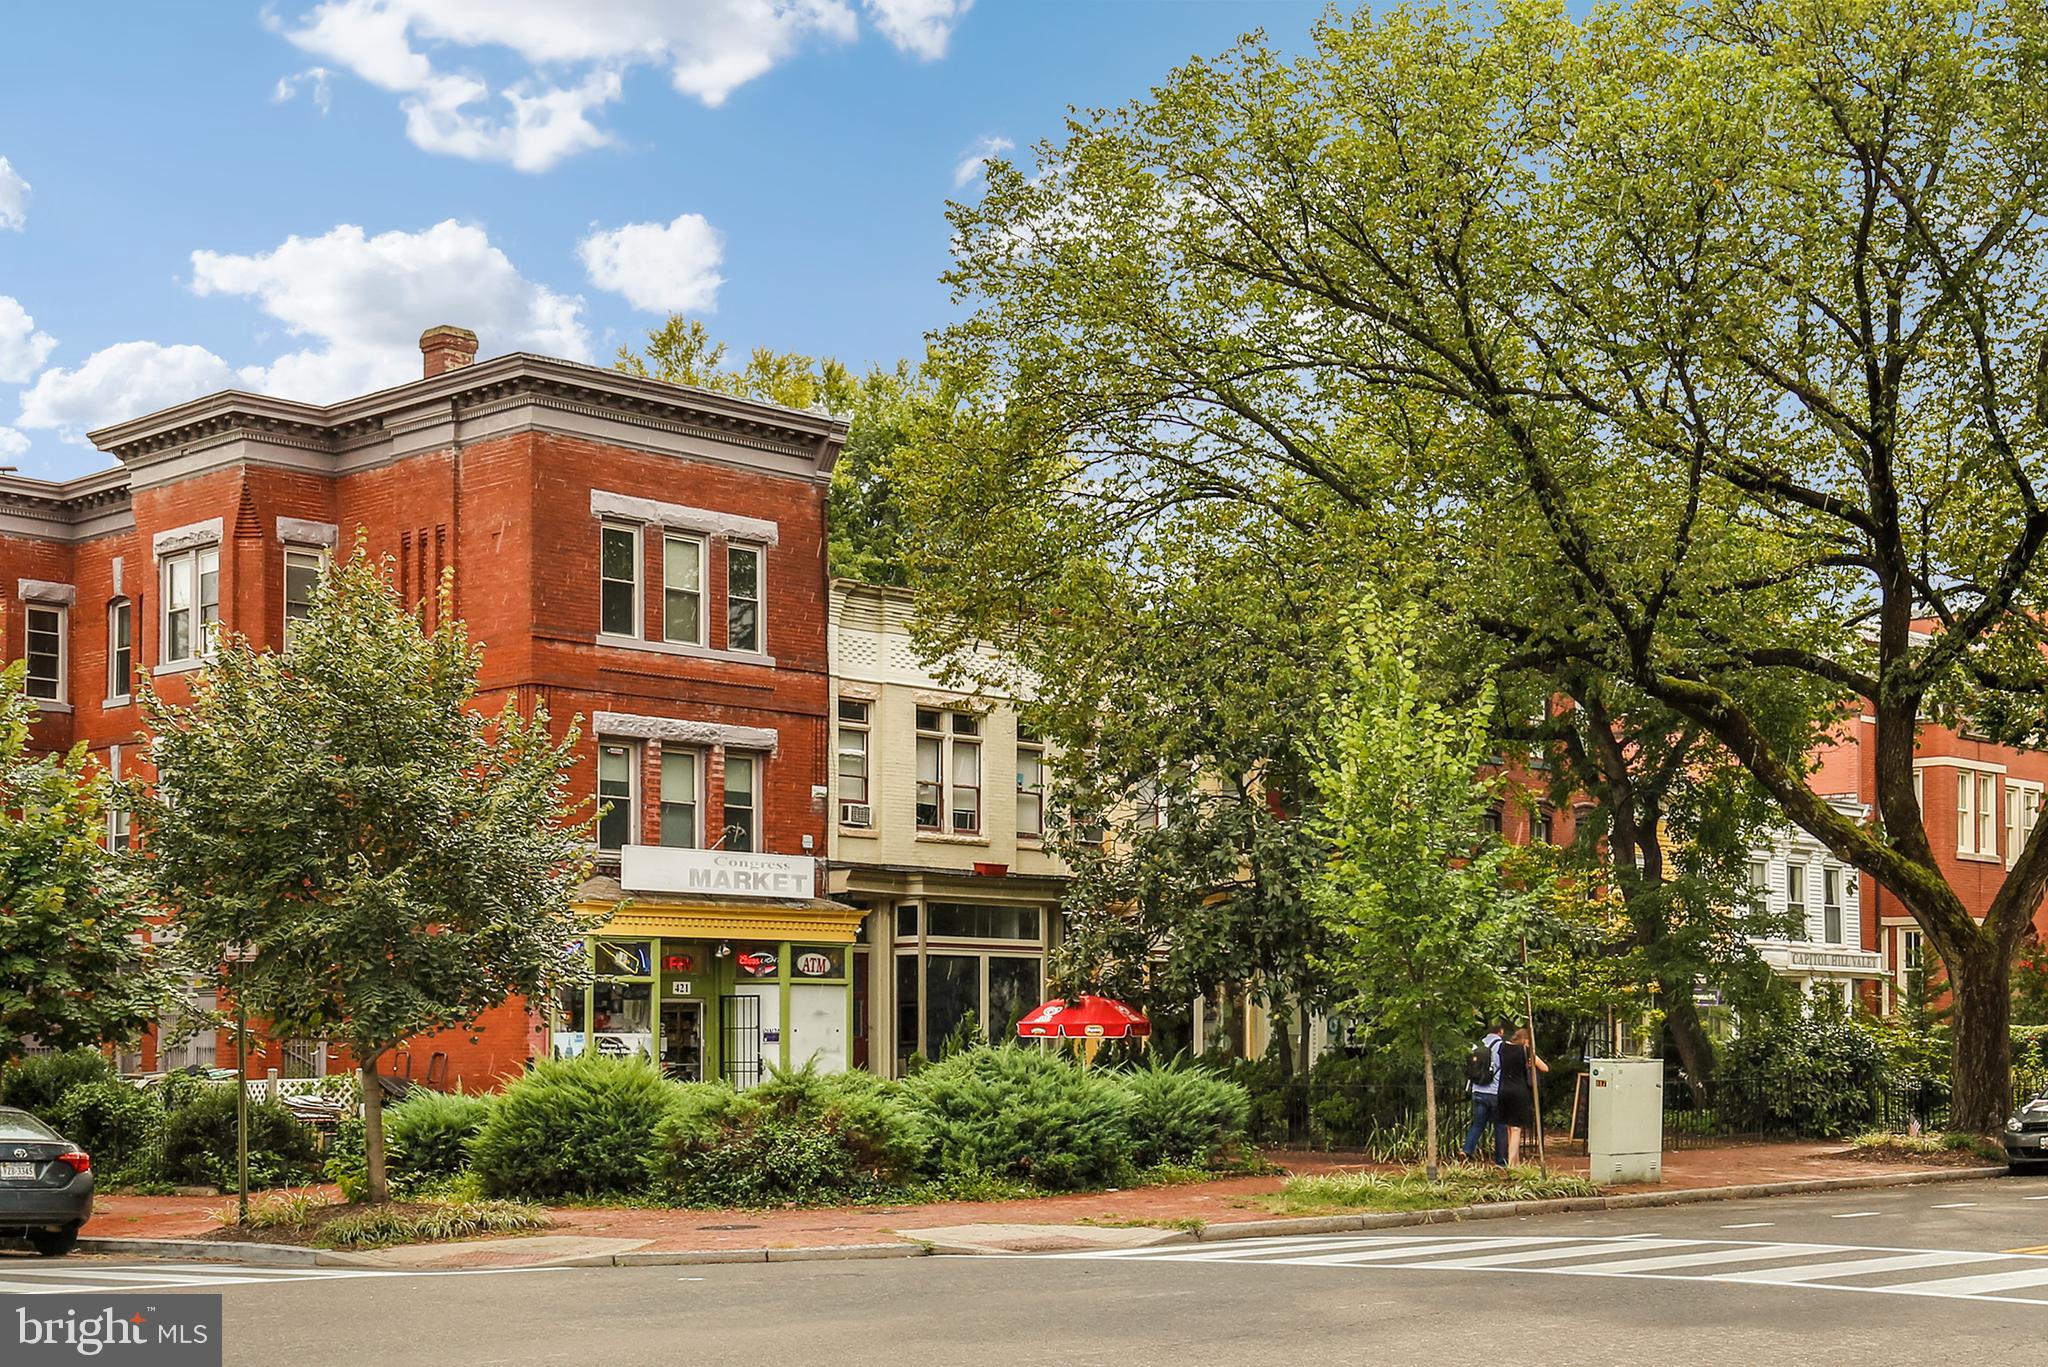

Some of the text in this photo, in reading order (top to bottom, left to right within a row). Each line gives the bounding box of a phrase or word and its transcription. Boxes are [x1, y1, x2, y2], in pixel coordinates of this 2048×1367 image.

[714, 856, 790, 870] Congress
[689, 868, 808, 892] MARKET
[803, 957, 826, 974] ATM
[1792, 952, 1876, 968] CAPITOL HILL VALET
[674, 983, 689, 993] 421
